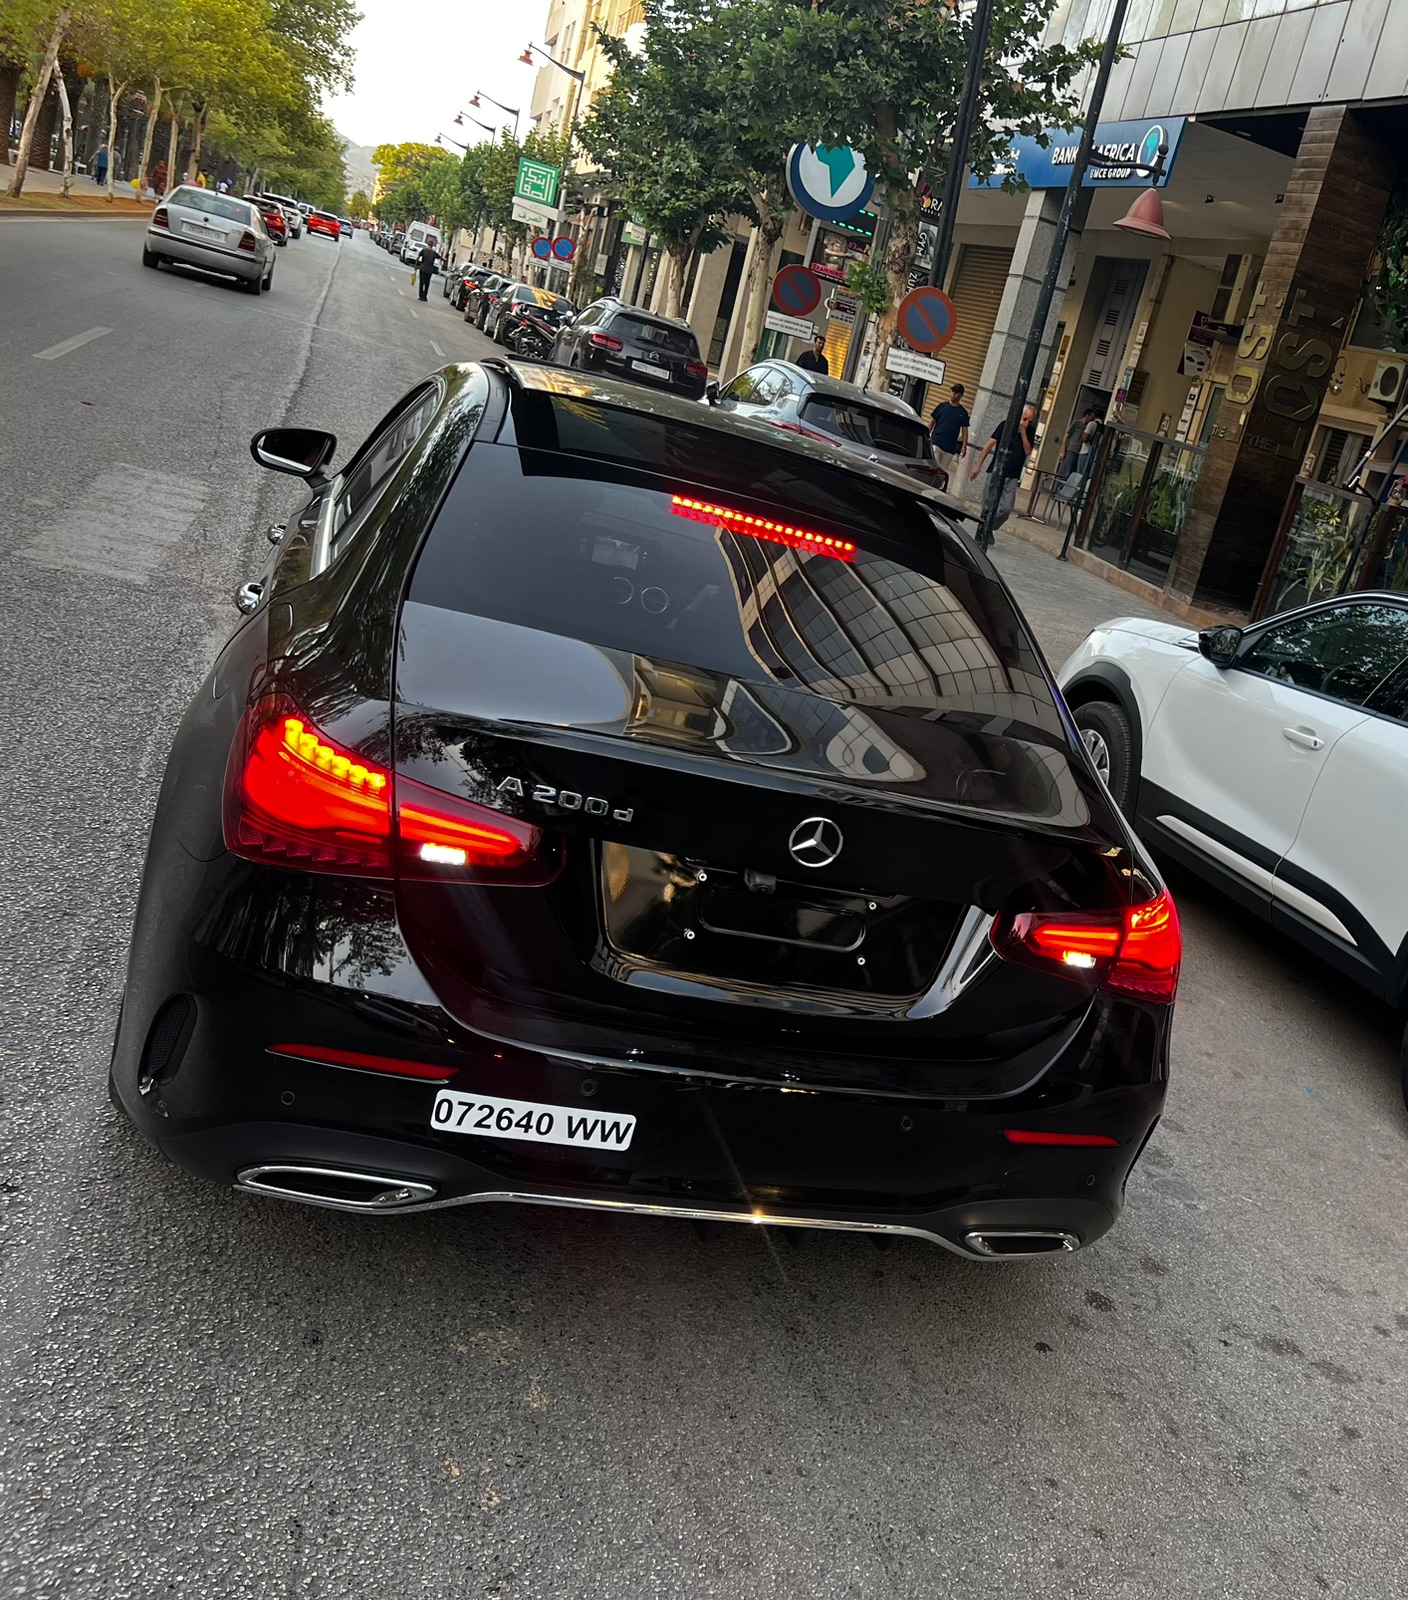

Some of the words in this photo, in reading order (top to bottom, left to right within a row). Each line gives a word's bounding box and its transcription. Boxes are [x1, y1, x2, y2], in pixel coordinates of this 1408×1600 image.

[1051, 146, 1080, 164] BANK
[1107, 168, 1131, 178] GROUP
[916, 232, 928, 257] GYM
[1211, 424, 1228, 439] THE
[496, 775, 525, 798] A
[433, 1098, 555, 1136] 072640
[566, 1115, 633, 1145] WW
